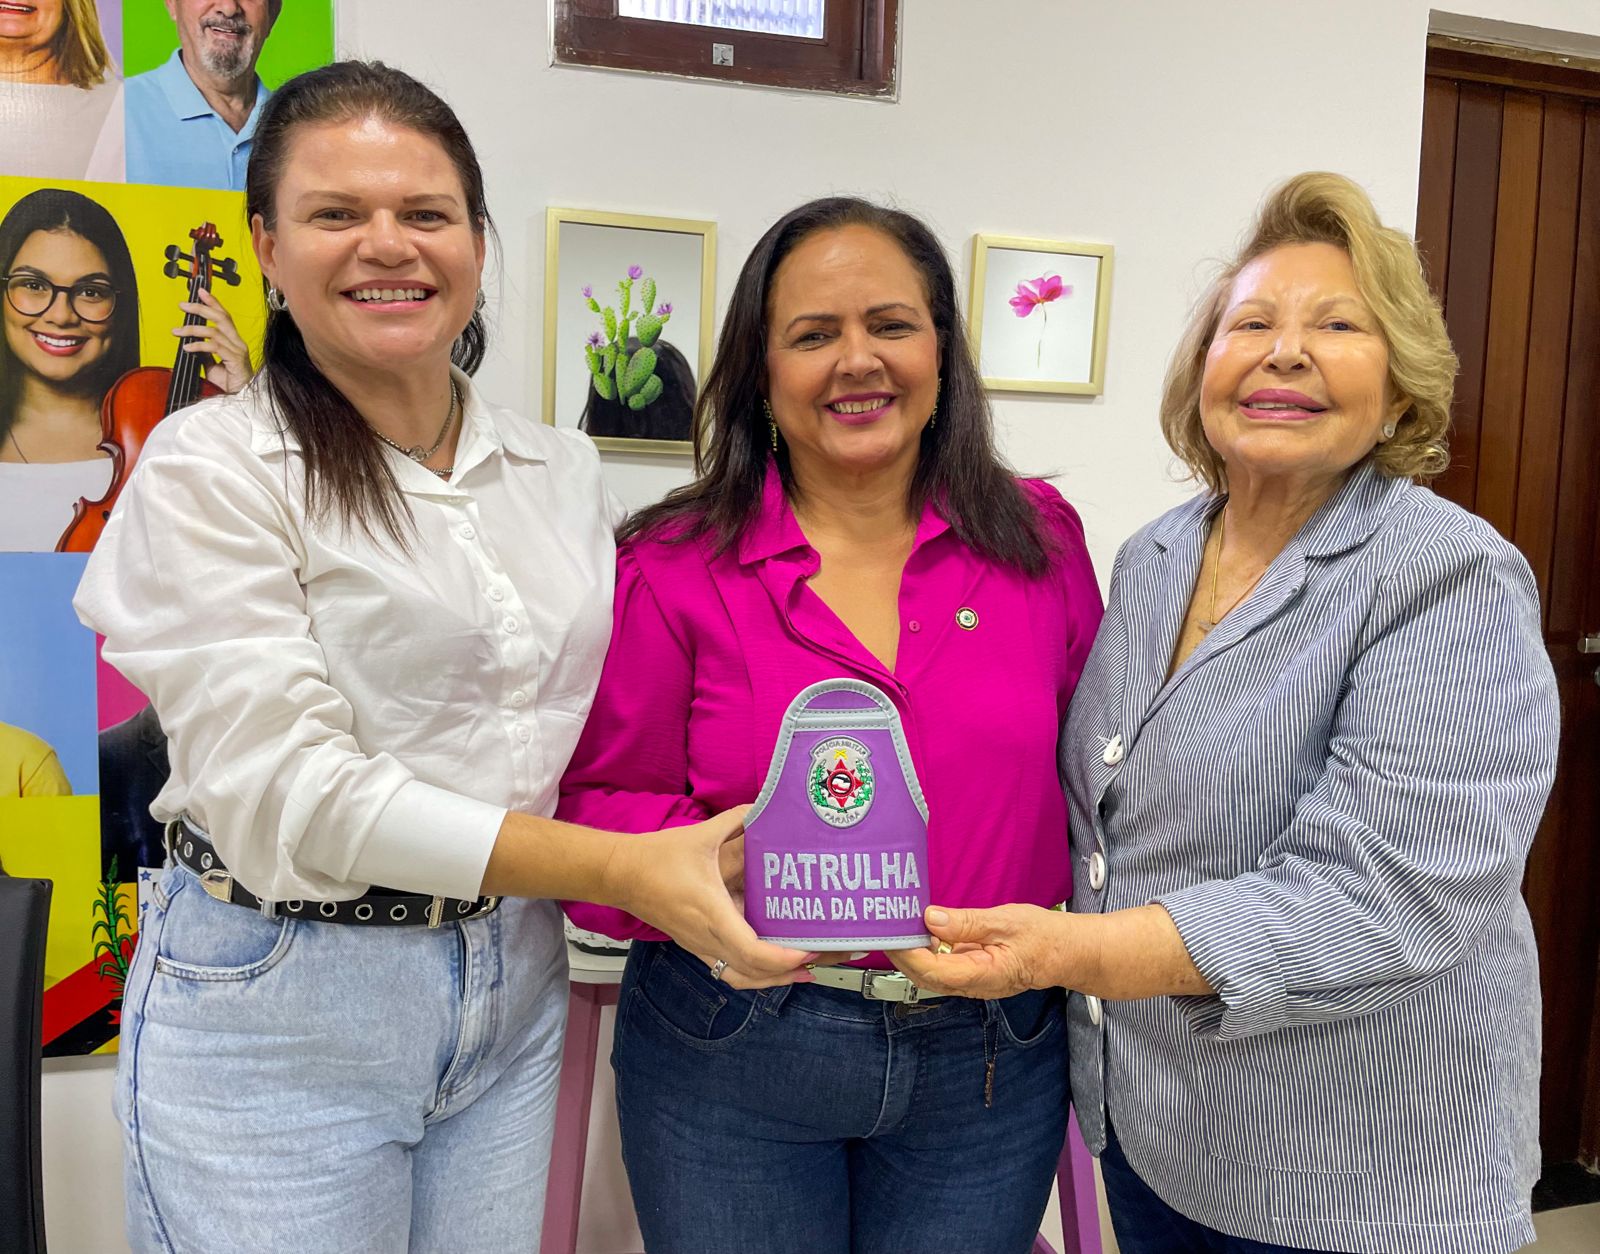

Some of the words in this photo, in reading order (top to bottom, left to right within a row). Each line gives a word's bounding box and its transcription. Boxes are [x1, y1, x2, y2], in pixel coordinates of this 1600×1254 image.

[763, 852, 921, 891] PATRULHA
[766, 896, 826, 920] MARIA
[831, 897, 857, 920] DA
[863, 895, 921, 920] PENHA
